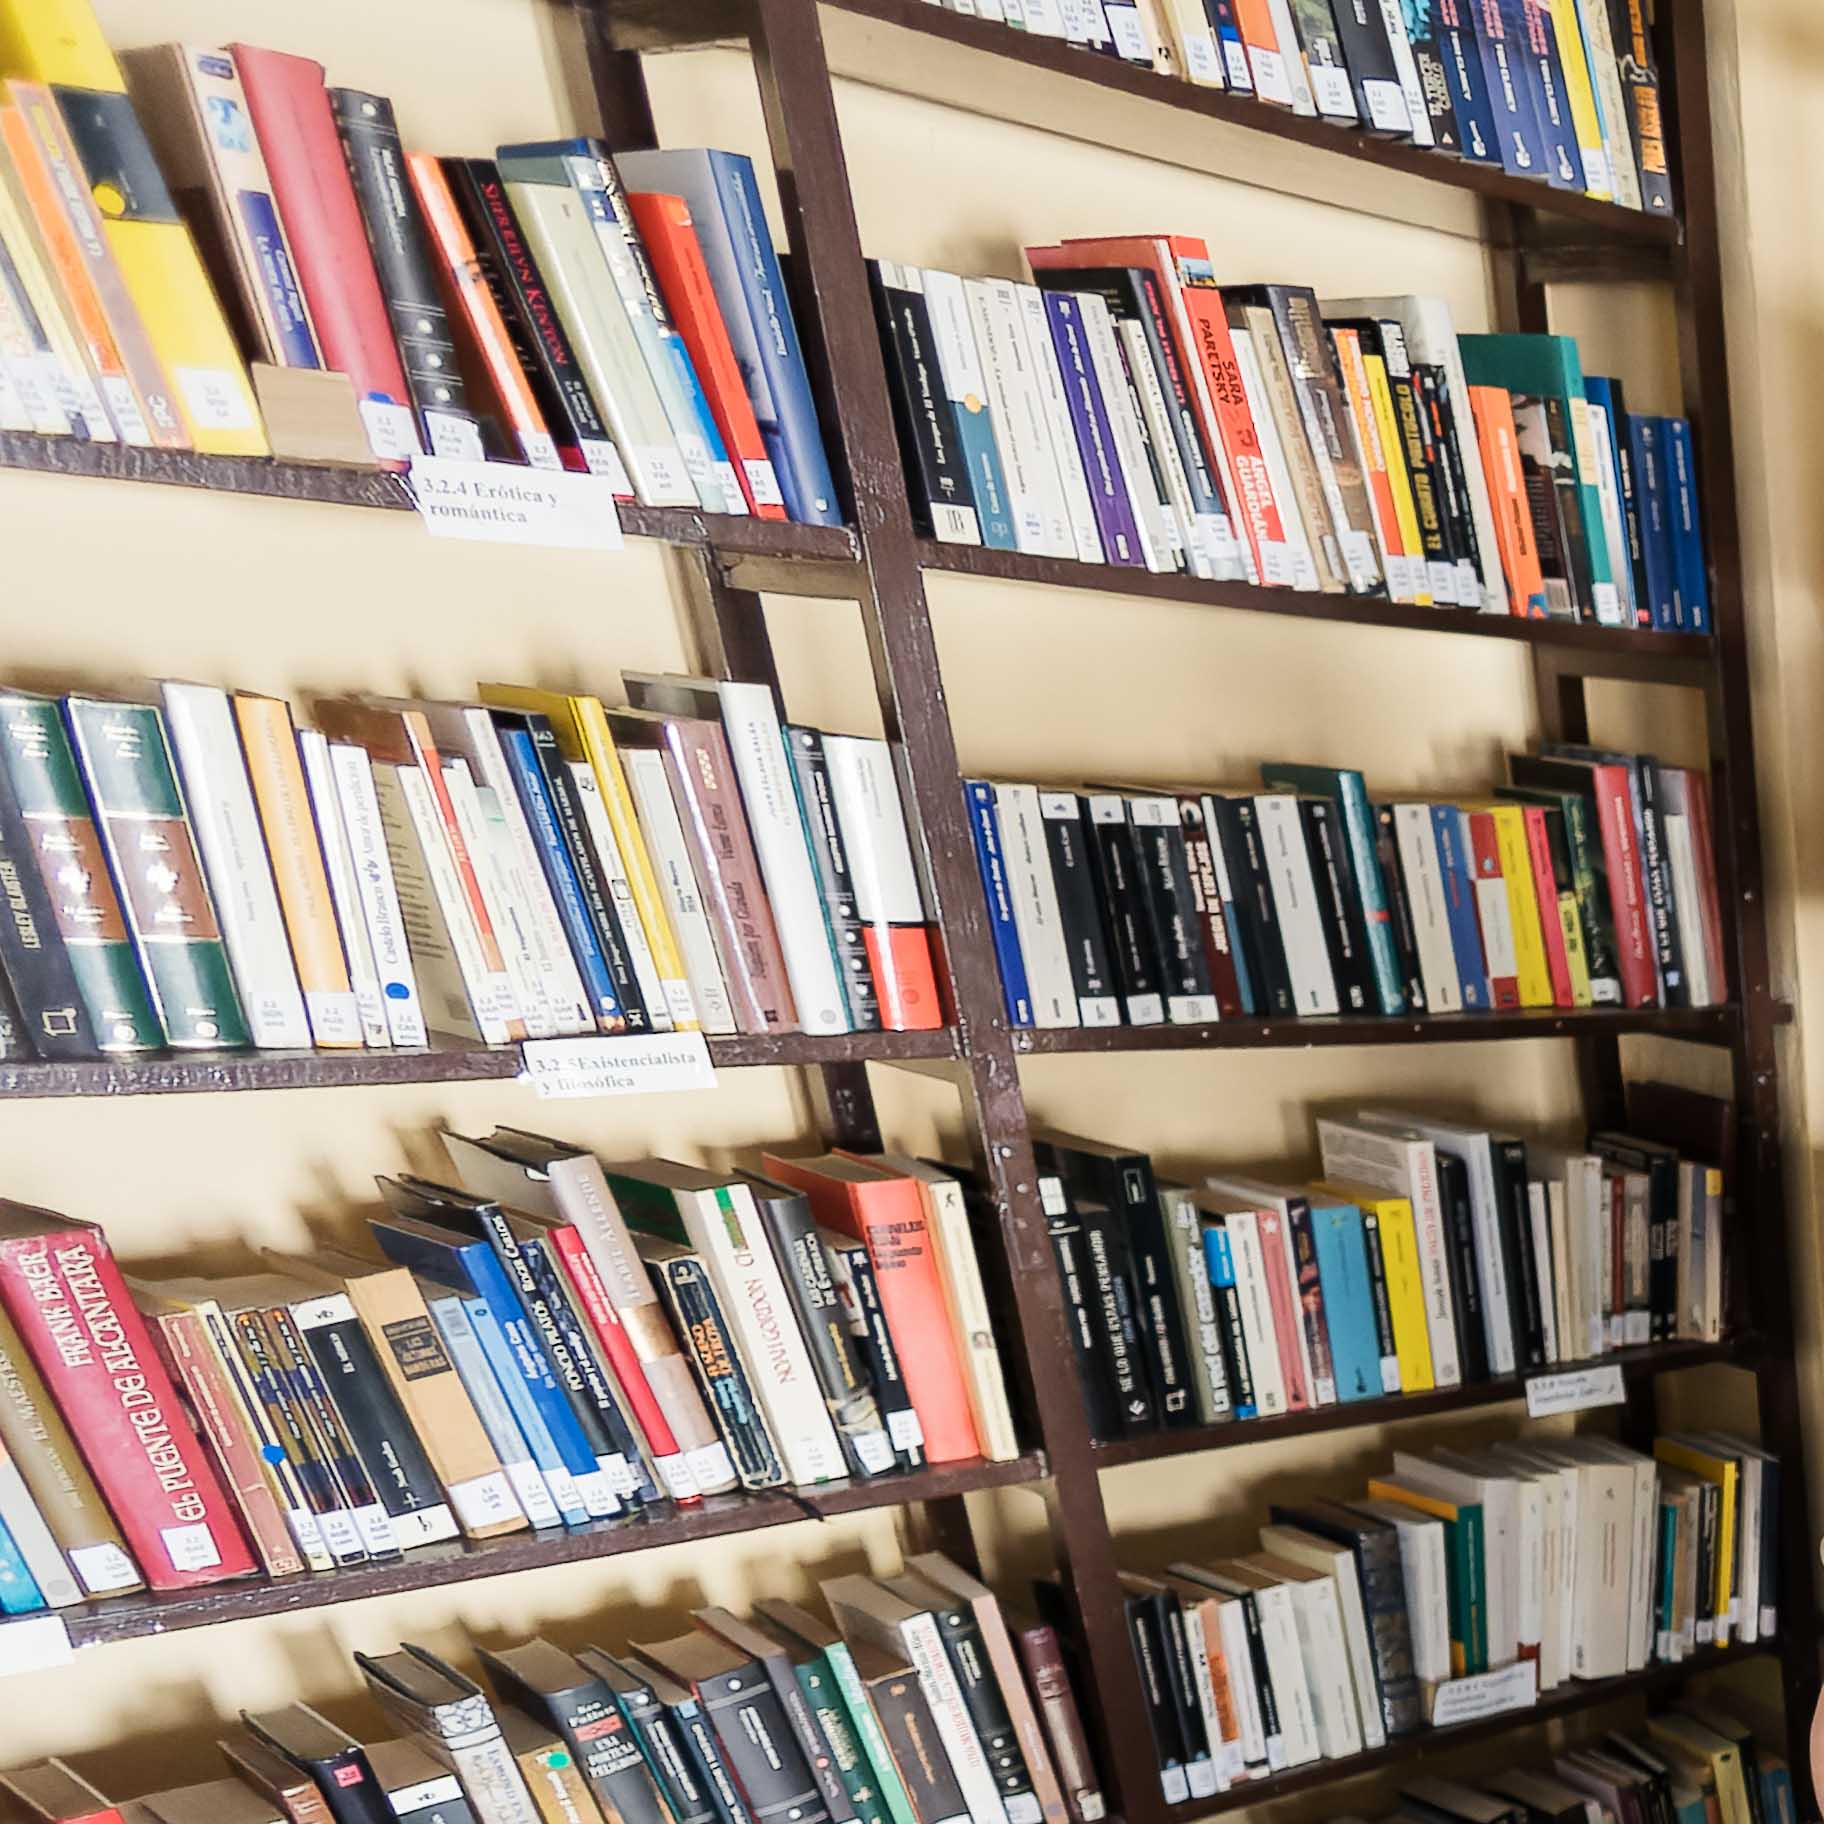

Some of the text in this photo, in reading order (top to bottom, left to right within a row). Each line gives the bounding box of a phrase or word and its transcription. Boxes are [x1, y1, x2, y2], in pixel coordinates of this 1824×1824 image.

[1198, 317, 1232, 405] PARETSKY
[1222, 360, 1244, 407] SARA
[423, 478, 469, 496] 3.2.4
[473, 480, 545, 503] Erótica
[428, 503, 528, 525] romántica
[18, 1247, 94, 1369] FRANK BAER
[511, 1259, 536, 1293] ROGER
[532, 1300, 585, 1393] PONCIO PILATOS
[54, 1244, 206, 1522] EL PUENTE DE ALCANTARA
